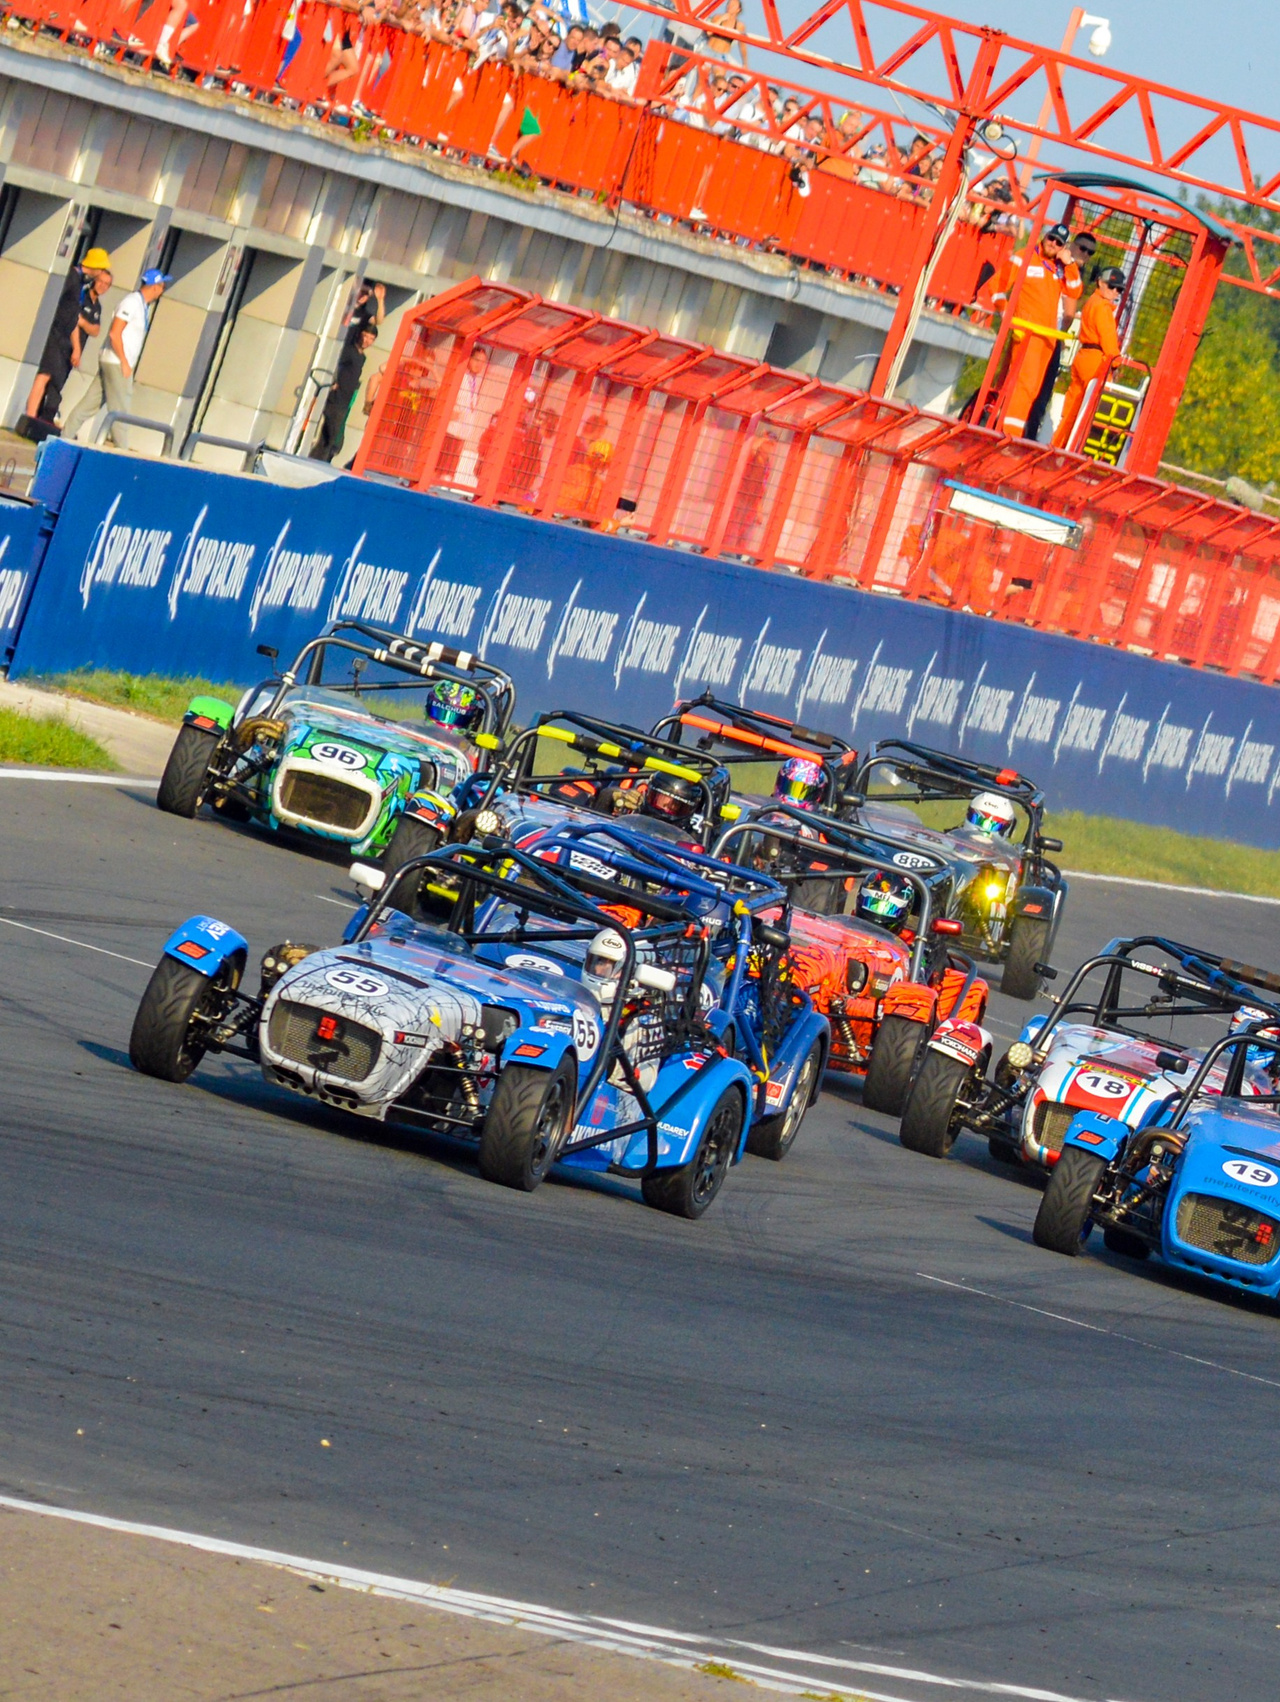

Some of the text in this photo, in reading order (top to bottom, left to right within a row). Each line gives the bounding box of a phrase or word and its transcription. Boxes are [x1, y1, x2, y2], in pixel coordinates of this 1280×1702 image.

[318, 745, 359, 766] 96
[331, 972, 383, 993] 55
[577, 1019, 597, 1050] 55
[1086, 1076, 1124, 1095] 18
[1231, 1163, 1272, 1183] 19
